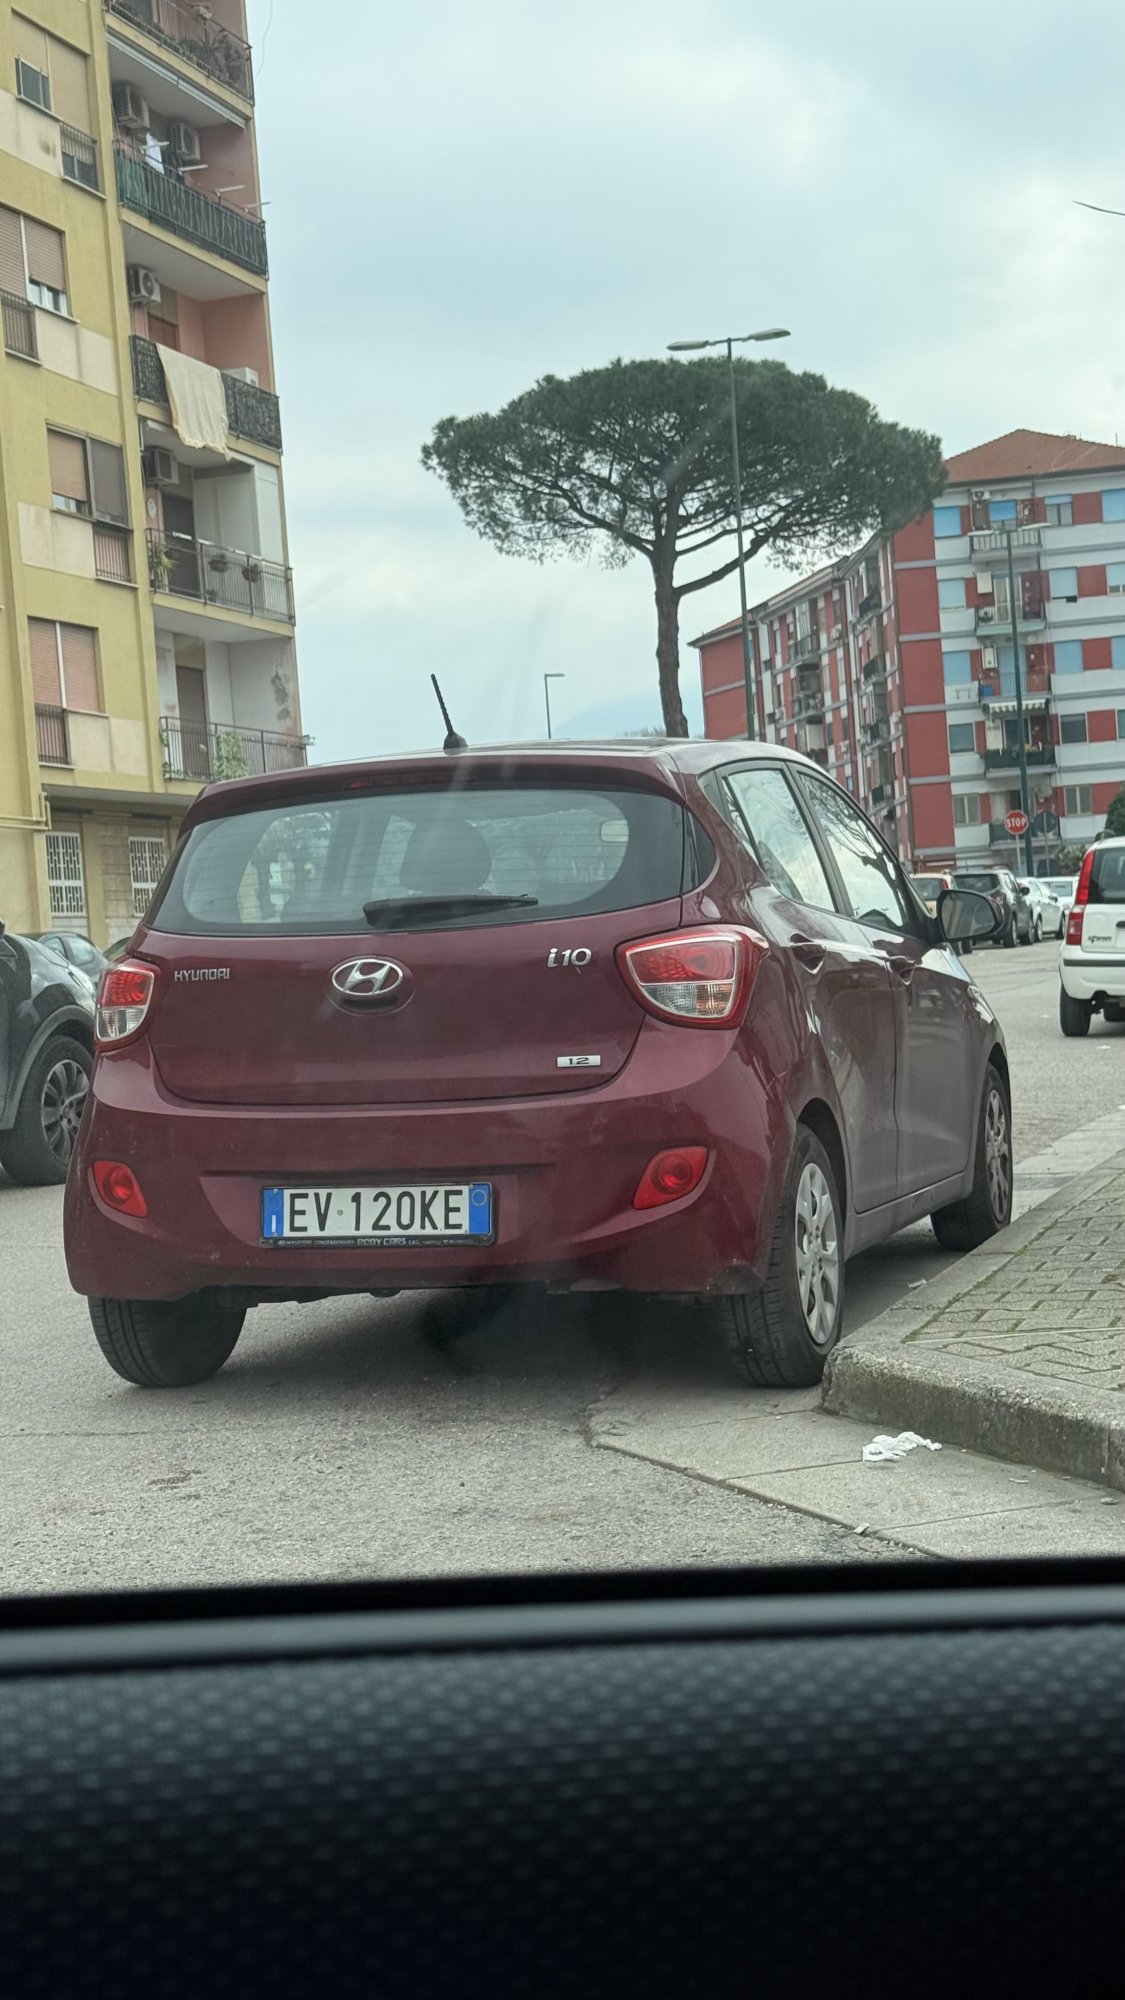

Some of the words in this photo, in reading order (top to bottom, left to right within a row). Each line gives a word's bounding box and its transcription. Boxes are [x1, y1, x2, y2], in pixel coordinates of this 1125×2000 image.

[1006, 817, 1026, 828] STOP
[547, 947, 592, 968] i10
[174, 968, 230, 982] HYUNDAI
[568, 1057, 590, 1066] 1.2
[289, 1192, 333, 1232] EV
[351, 1189, 463, 1232] 120KE
